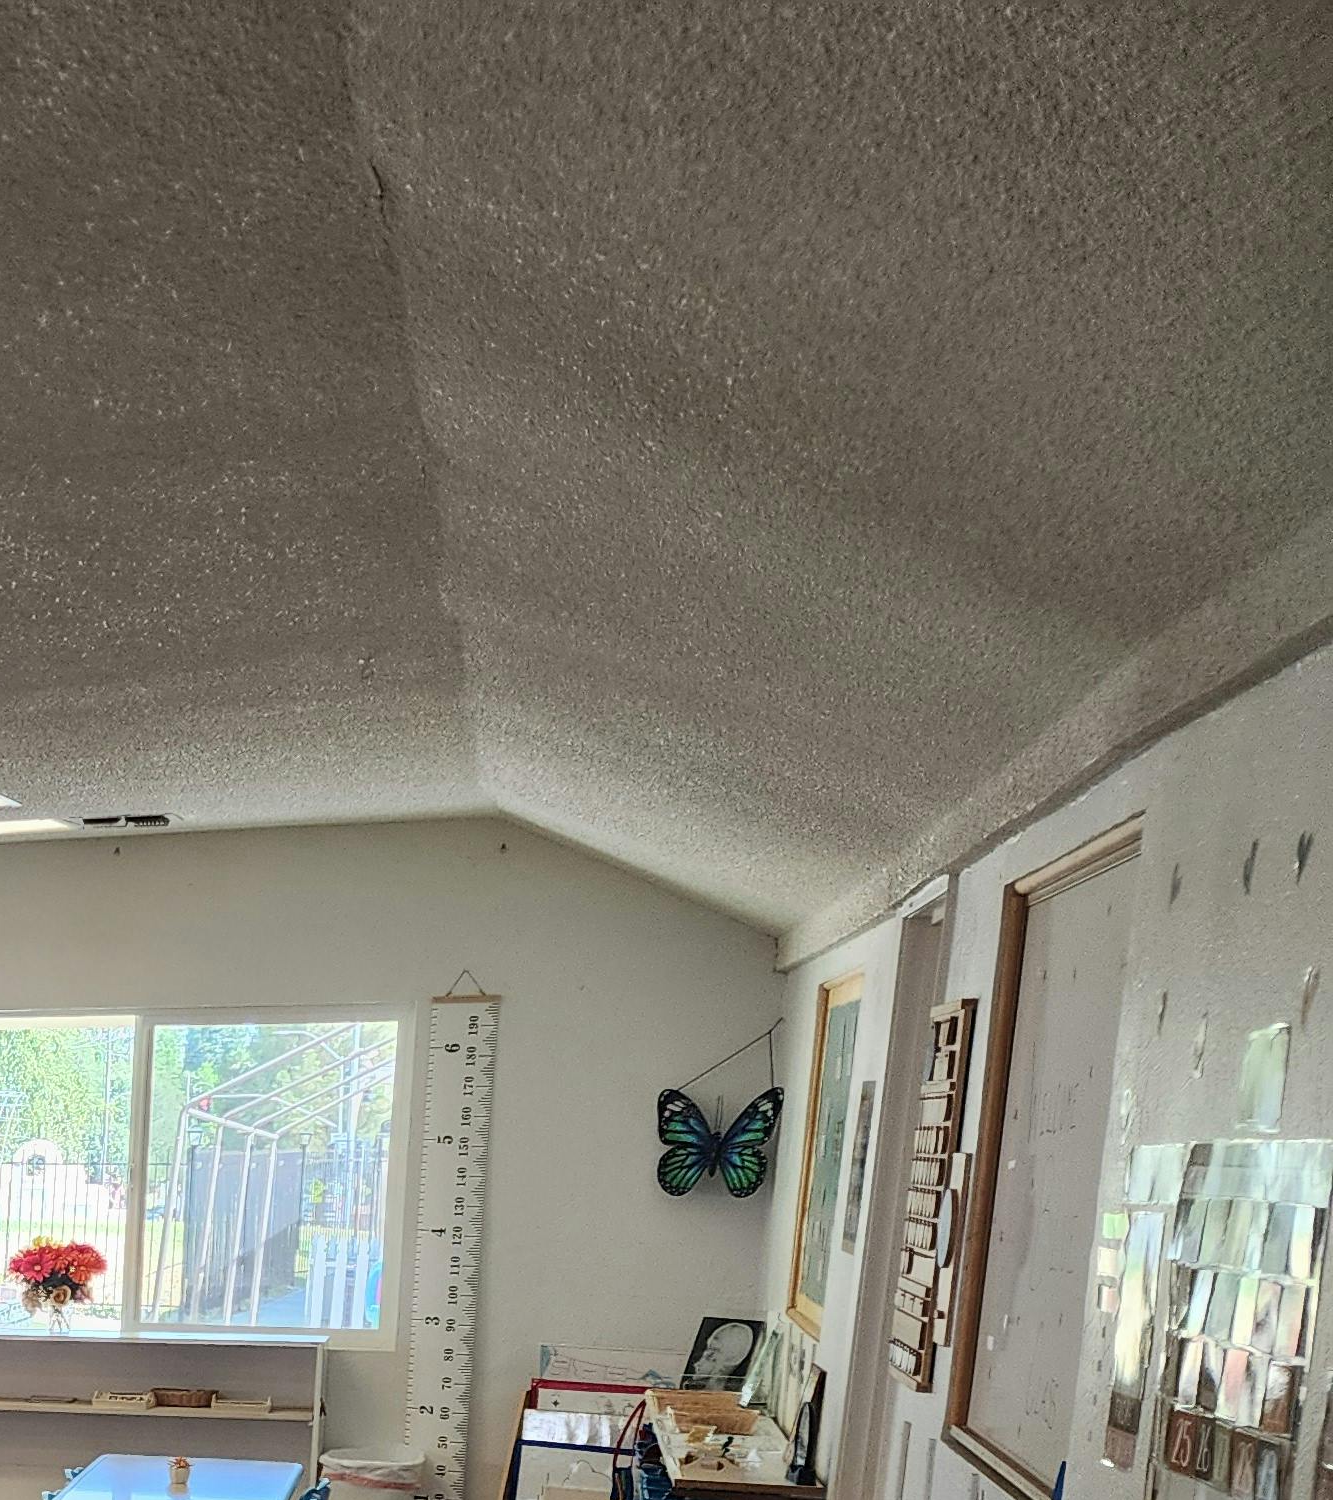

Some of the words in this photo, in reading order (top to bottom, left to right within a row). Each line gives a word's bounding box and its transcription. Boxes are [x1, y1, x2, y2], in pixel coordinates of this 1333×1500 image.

[468, 1015, 479, 1036] 190
[444, 1043, 461, 1053] 6
[465, 1046, 477, 1067] 180
[463, 1076, 474, 1096] 170
[460, 1106, 472, 1127] 160
[437, 1135, 454, 1145] 5
[458, 1136, 470, 1157] 150
[456, 1166, 468, 1187] 140
[454, 1196, 465, 1217] 130
[431, 1227, 447, 1238] 4
[452, 1226, 463, 1246] 120
[449, 1255, 461, 1276] 110
[447, 1285, 459, 1306] 100
[424, 1316, 441, 1326] 3
[445, 1318, 456, 1332] 90
[443, 1348, 454, 1362] 80
[441, 1376, 453, 1391] 70
[419, 1405, 434, 1415] 2
[439, 1406, 451, 1420] 60
[437, 1435, 448, 1449] 50
[1171, 1418, 1193, 1467] 25
[1196, 1423, 1211, 1472] 26
[435, 1464, 446, 1477] 40
